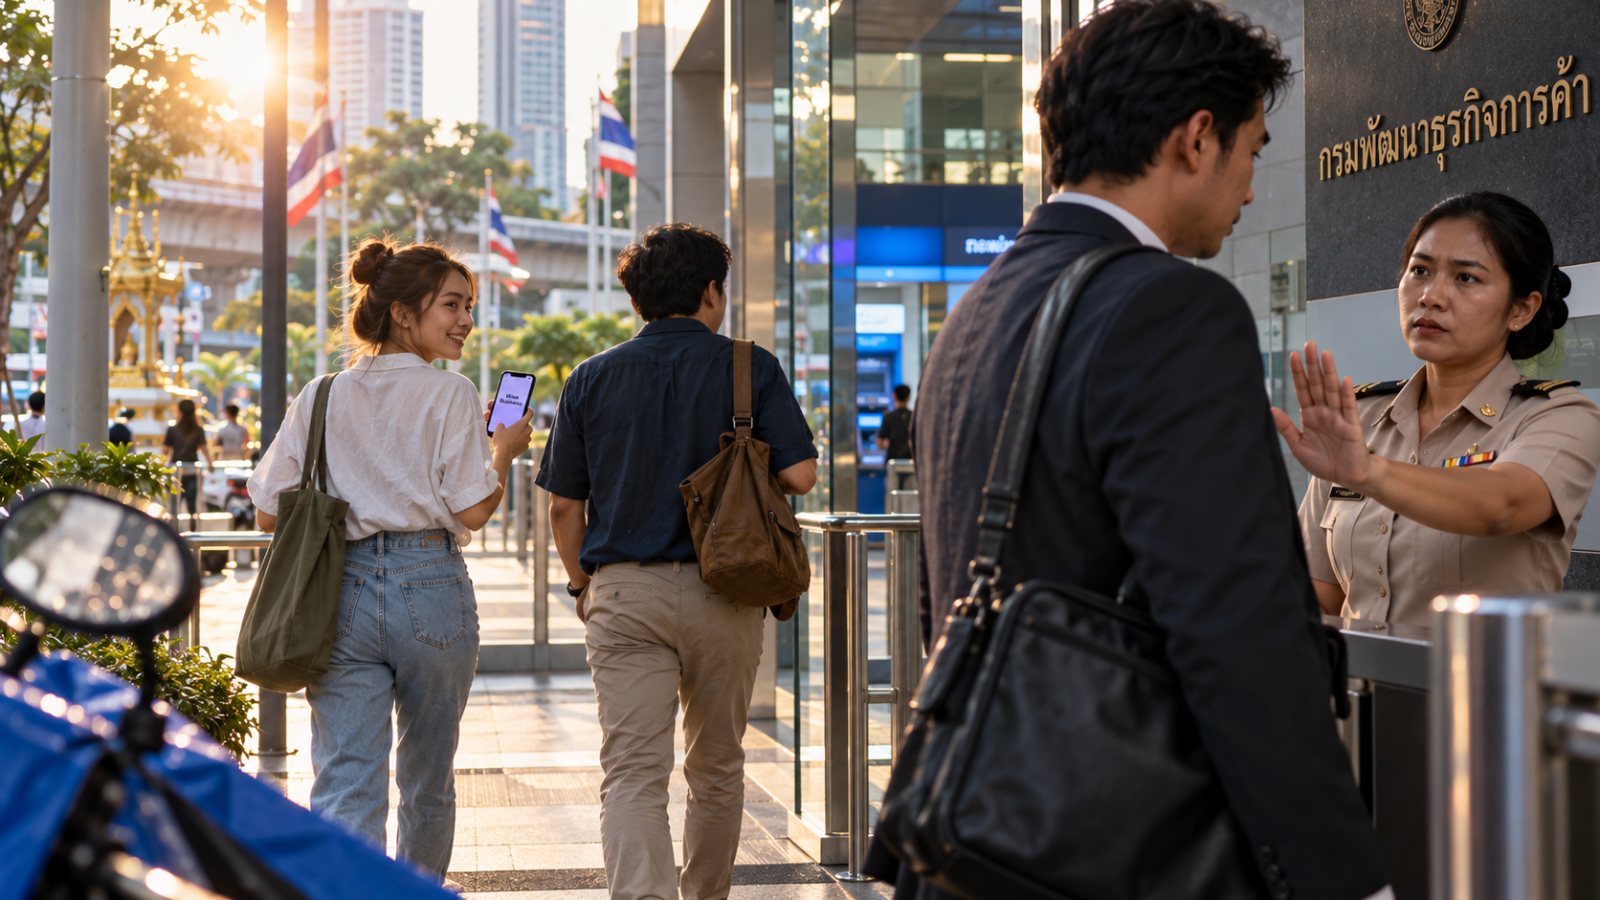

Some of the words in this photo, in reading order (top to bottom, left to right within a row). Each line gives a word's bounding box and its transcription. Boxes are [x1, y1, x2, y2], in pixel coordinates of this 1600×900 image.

[1319, 54, 1591, 181] กรมพัฒนาธุรกิจการค้า
